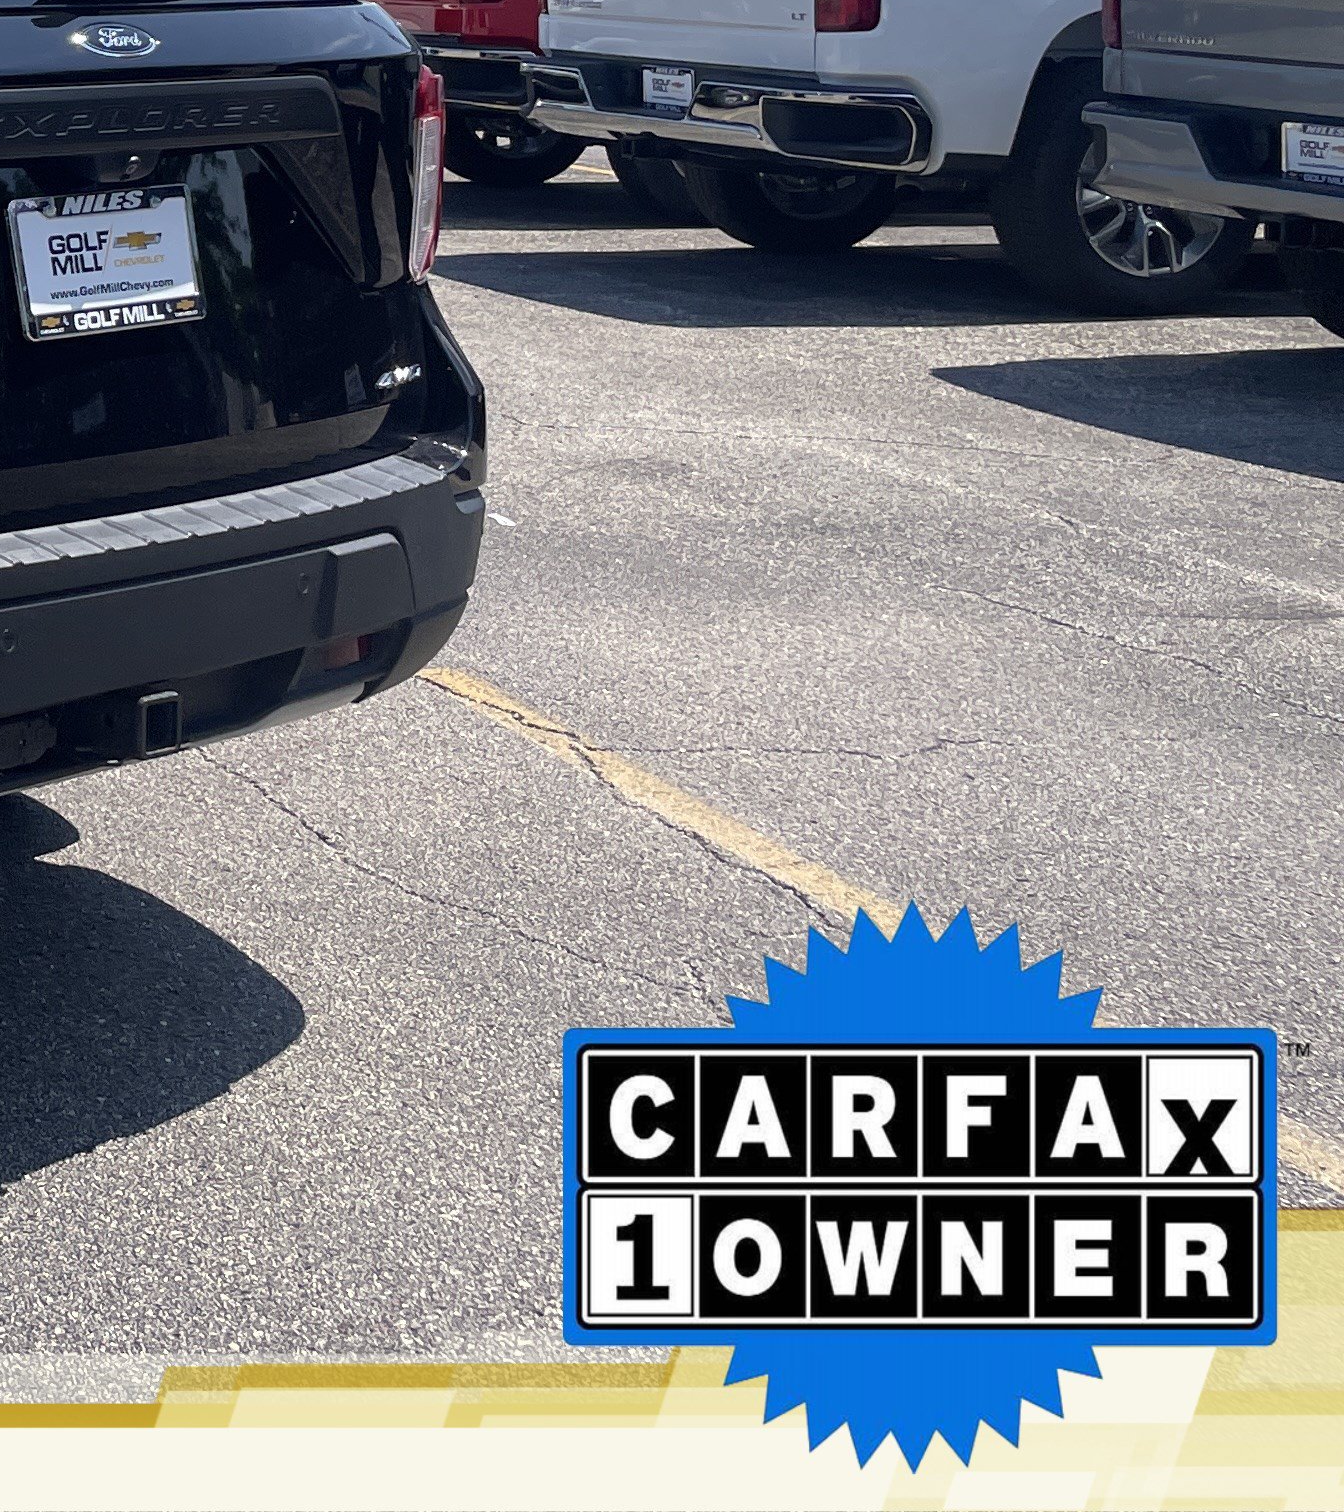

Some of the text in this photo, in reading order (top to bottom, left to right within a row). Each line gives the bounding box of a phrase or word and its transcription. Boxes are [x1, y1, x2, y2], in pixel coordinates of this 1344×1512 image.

[98, 27, 142, 48] Ford
[62, 190, 144, 216] NILES
[48, 230, 109, 255] GOLF
[51, 252, 103, 276] MILL
[114, 254, 166, 268] CHEVROLET
[50, 278, 174, 300] www.GolfMillChevy.com
[73, 303, 166, 331] GOLF MILL
